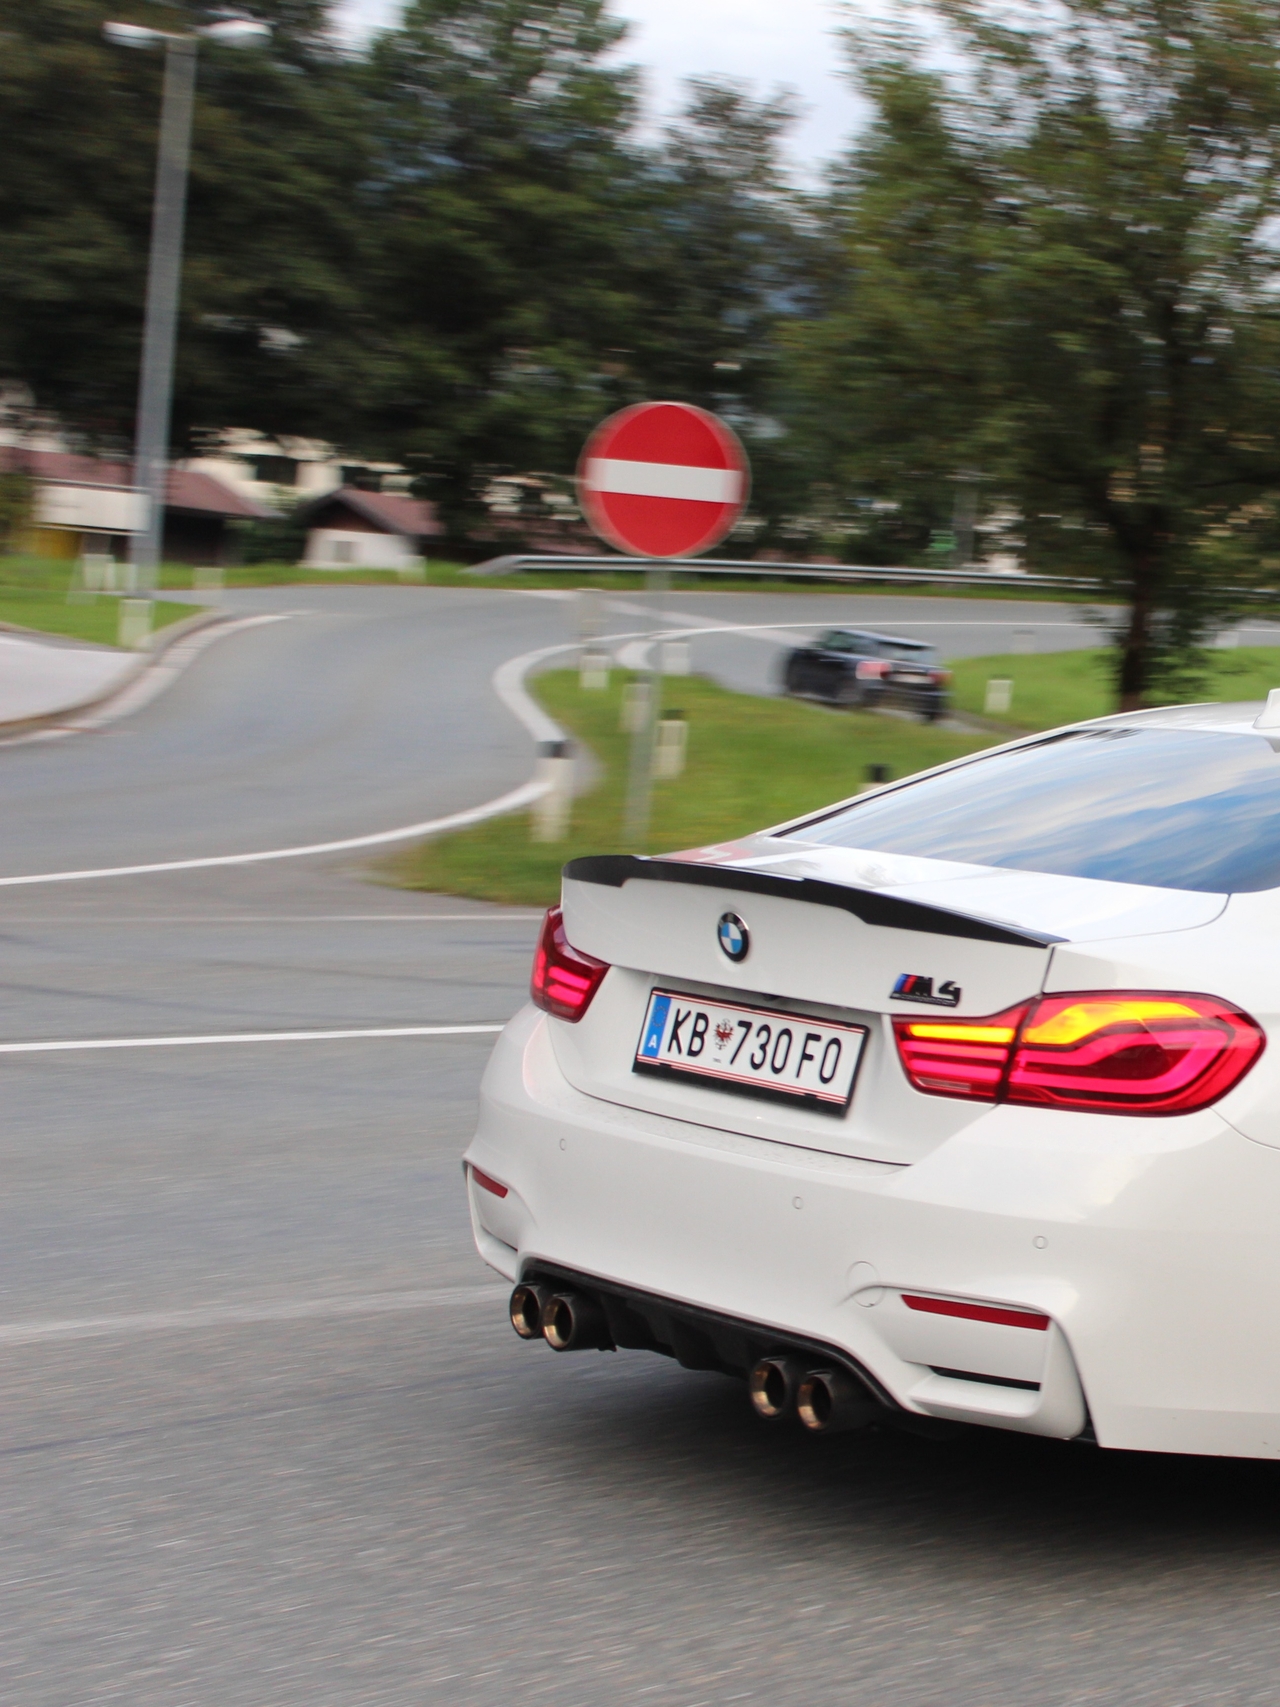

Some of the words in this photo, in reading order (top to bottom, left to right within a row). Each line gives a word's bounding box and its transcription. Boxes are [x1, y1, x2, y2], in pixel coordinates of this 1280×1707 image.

[890, 973, 962, 1007] M4
[647, 1033, 658, 1049] A
[667, 1008, 710, 1058] KB
[730, 1021, 793, 1075] 730
[796, 1032, 843, 1084] FO
